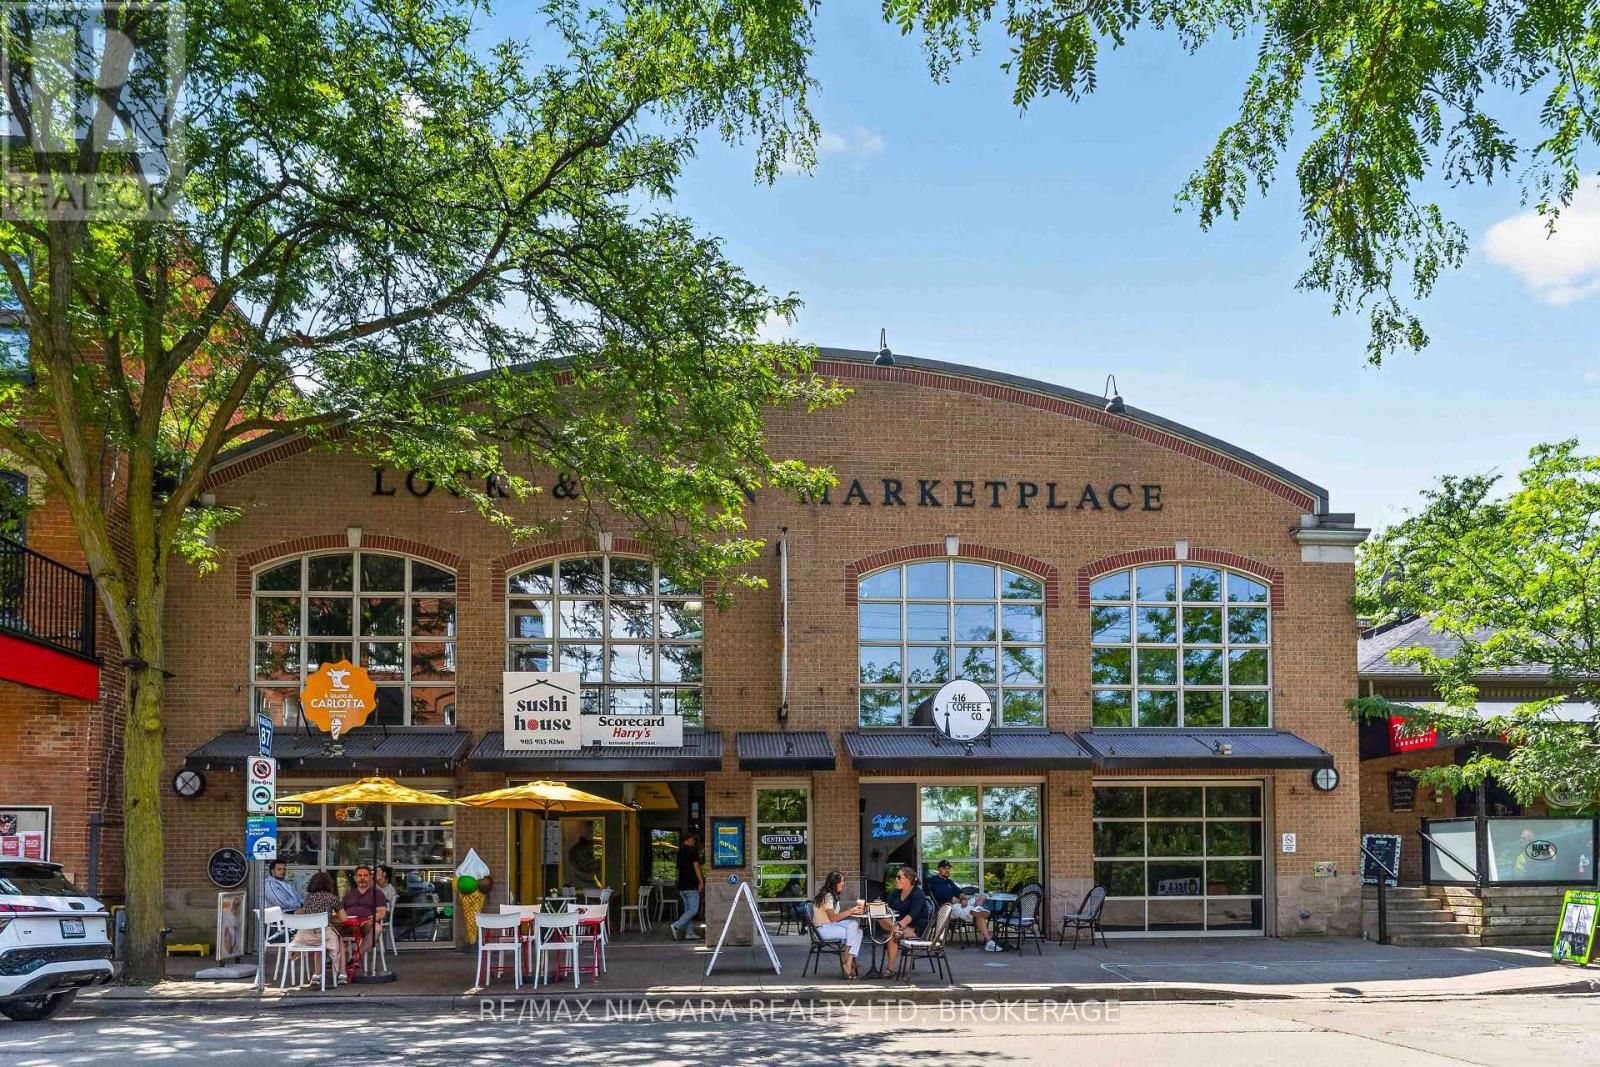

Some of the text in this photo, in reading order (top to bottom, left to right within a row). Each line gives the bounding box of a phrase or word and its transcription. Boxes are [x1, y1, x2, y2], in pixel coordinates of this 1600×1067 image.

[552, 471, 580, 499] &
[952, 693, 966, 702] 416
[311, 699, 365, 709] CARLOTTA
[517, 695, 568, 712] sushi
[952, 703, 982, 712] COFFEE
[598, 716, 665, 727] Scorecard
[971, 712, 984, 720] CO.
[514, 714, 572, 731] house
[261, 727, 271, 747] 87
[612, 727, 652, 740] Harry's
[278, 806, 301, 814] OPEN
